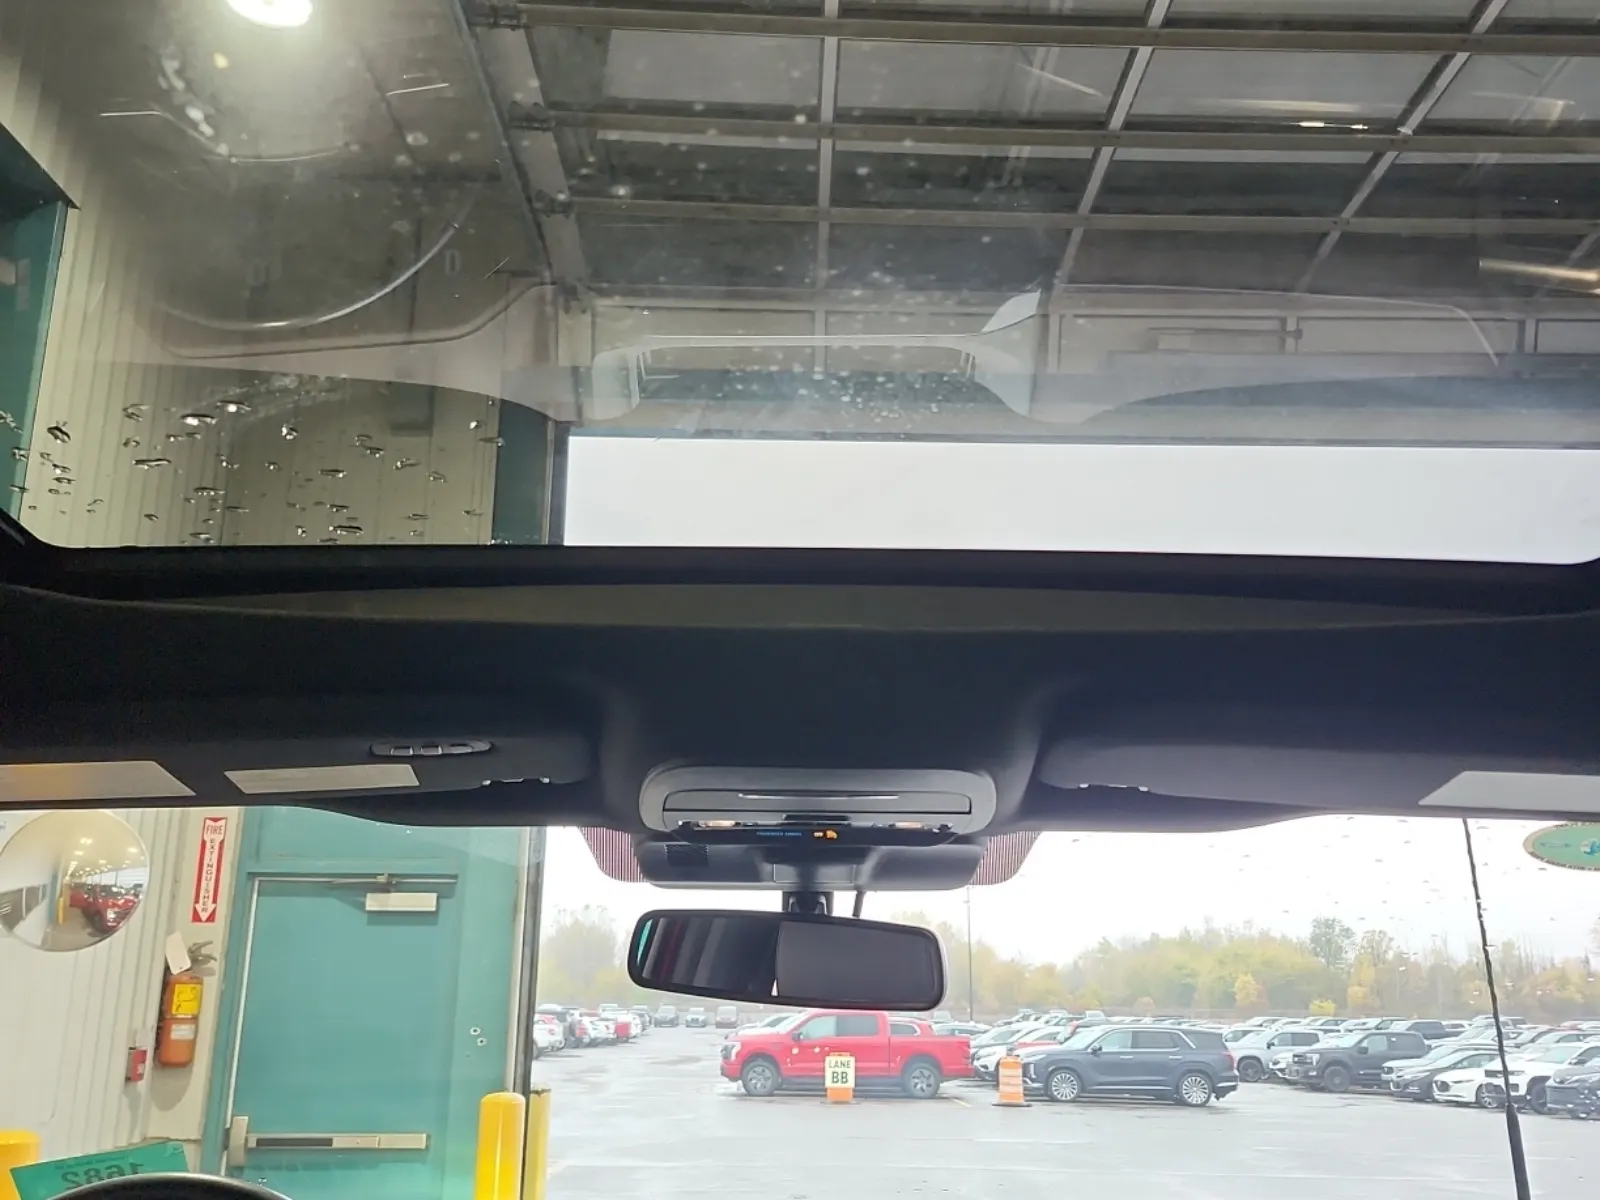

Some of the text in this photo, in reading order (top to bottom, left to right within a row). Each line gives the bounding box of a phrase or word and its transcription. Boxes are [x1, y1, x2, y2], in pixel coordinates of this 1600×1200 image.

[206, 824, 223, 835] FIRE
[201, 838, 215, 913] EXTINGUISHER
[828, 1059, 852, 1069] LANE
[831, 1071, 849, 1084] BB
